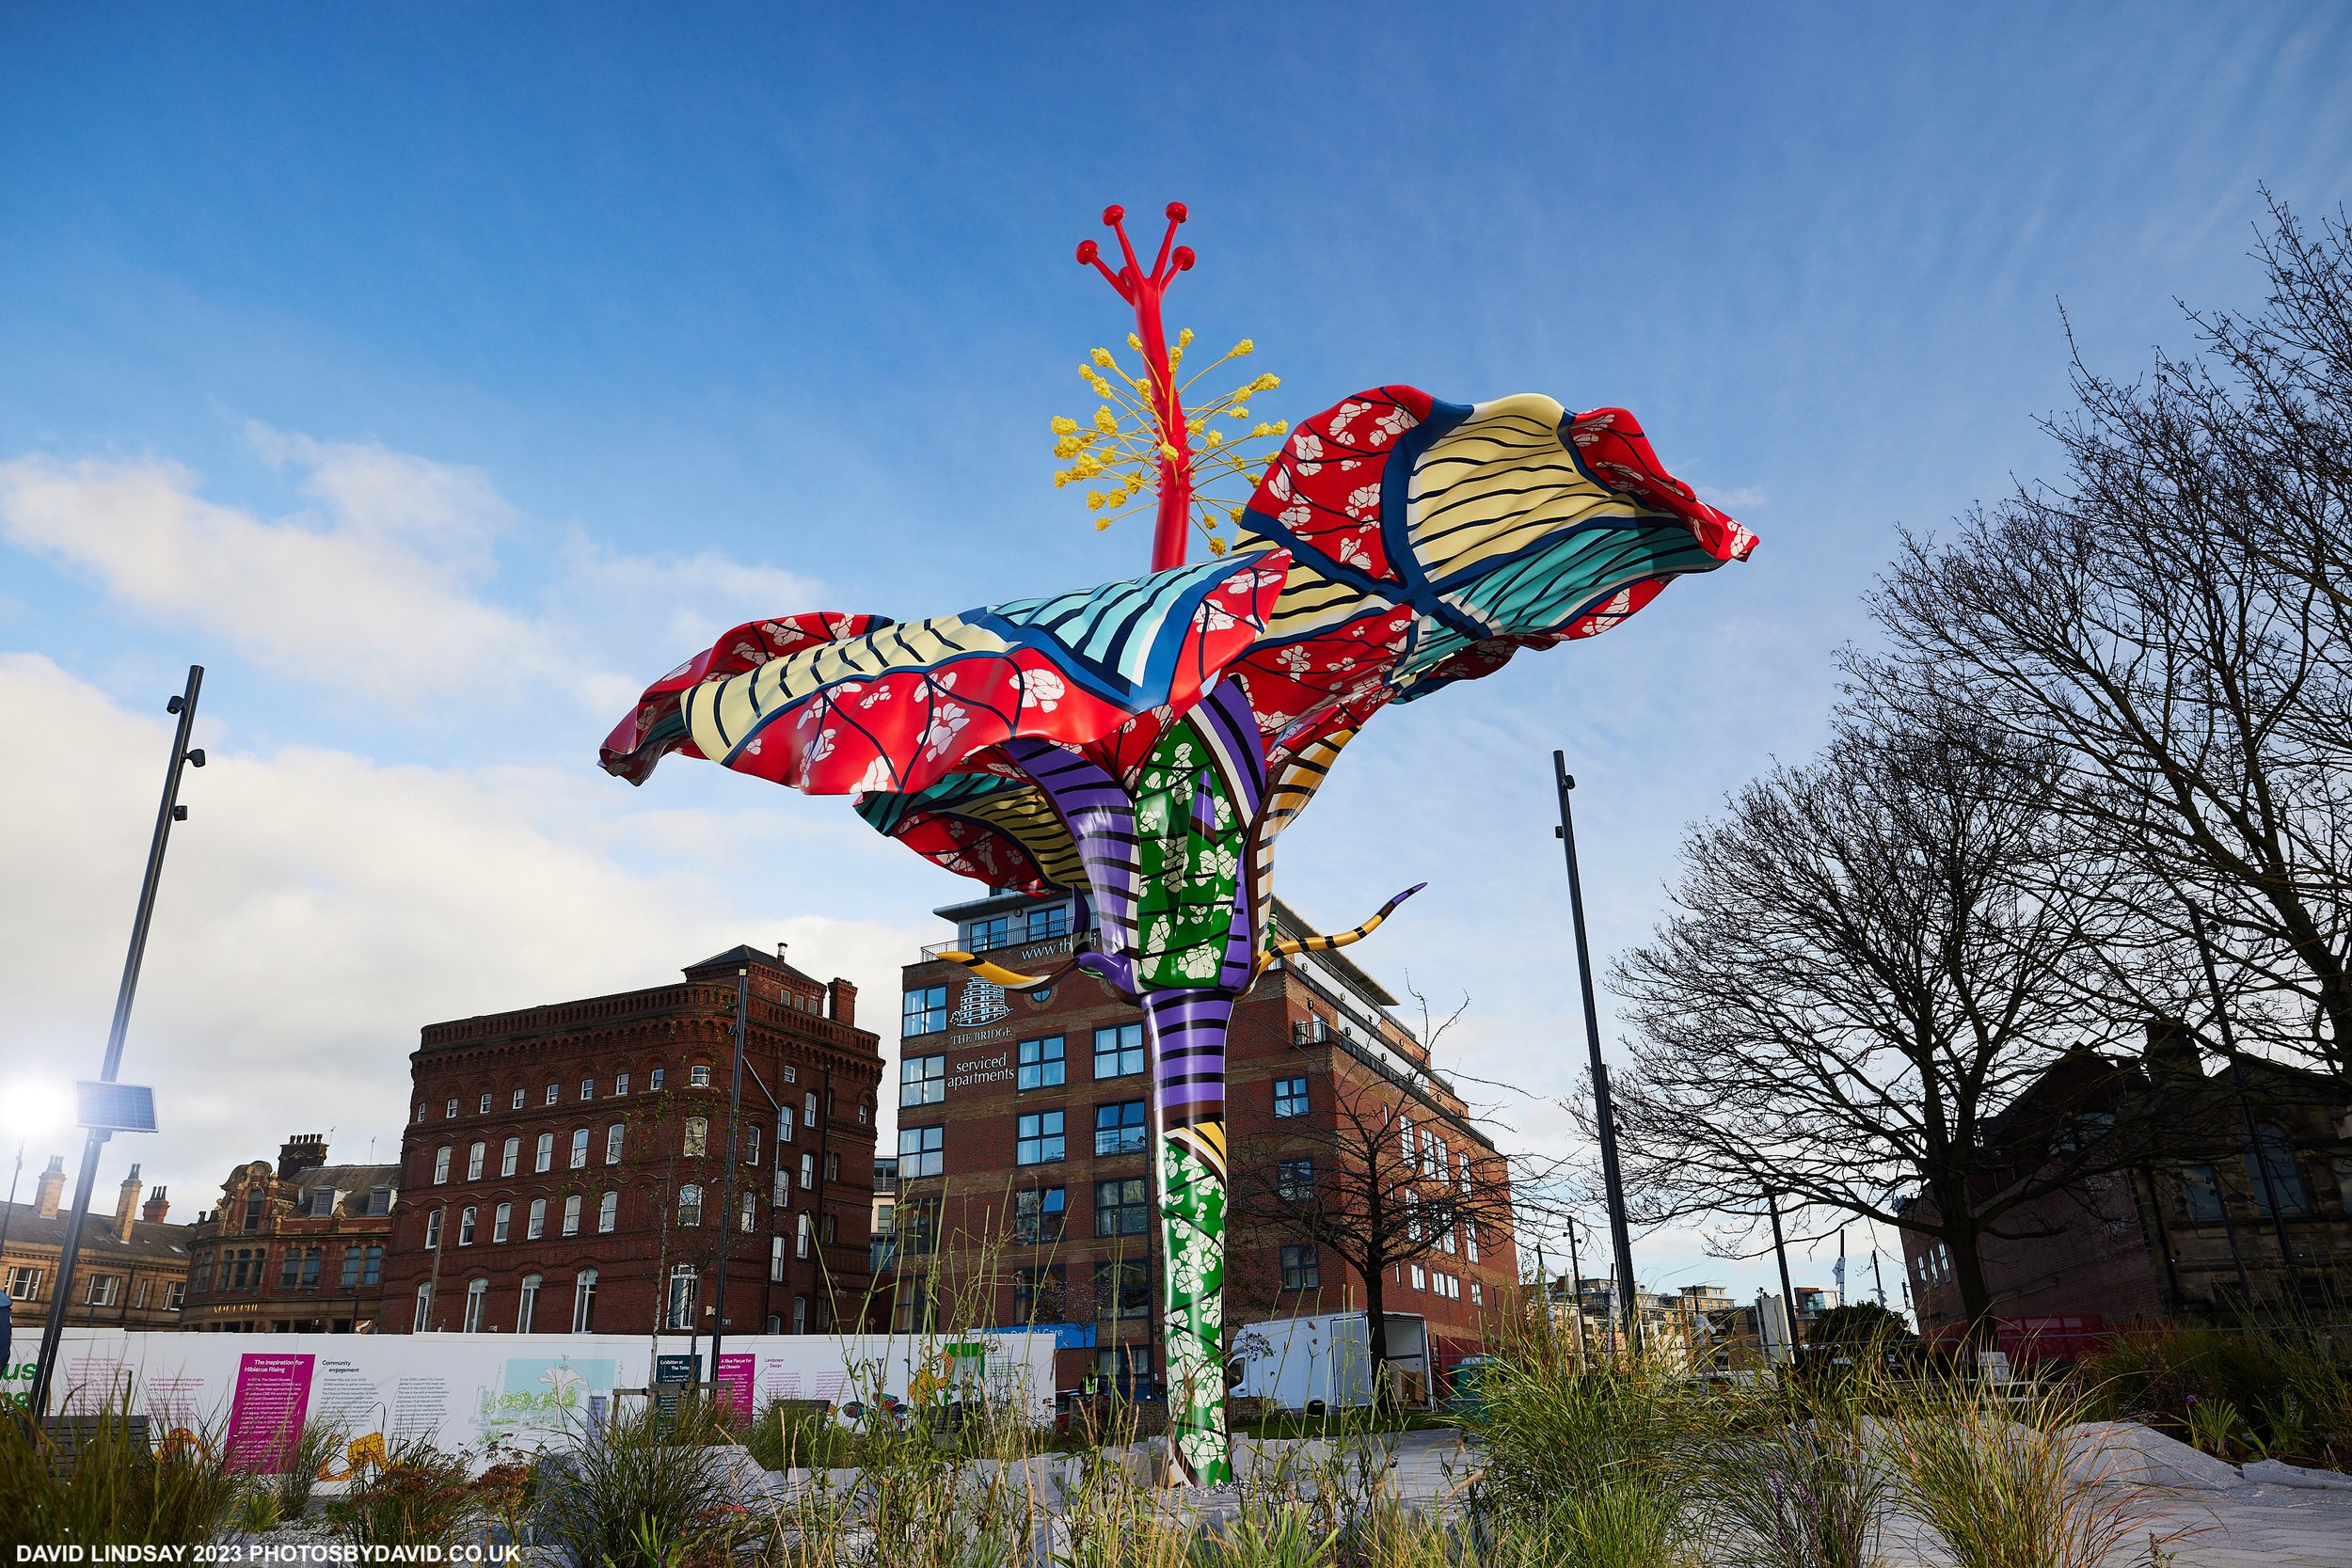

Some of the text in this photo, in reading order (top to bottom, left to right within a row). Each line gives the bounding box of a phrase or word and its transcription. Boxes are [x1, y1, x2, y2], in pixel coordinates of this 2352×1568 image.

[950, 1027, 1012, 1045] THE BRIDGE
[956, 1052, 1007, 1073] serviced
[947, 1068, 1015, 1091] apartments
[1042, 1327, 1064, 1337] Care
